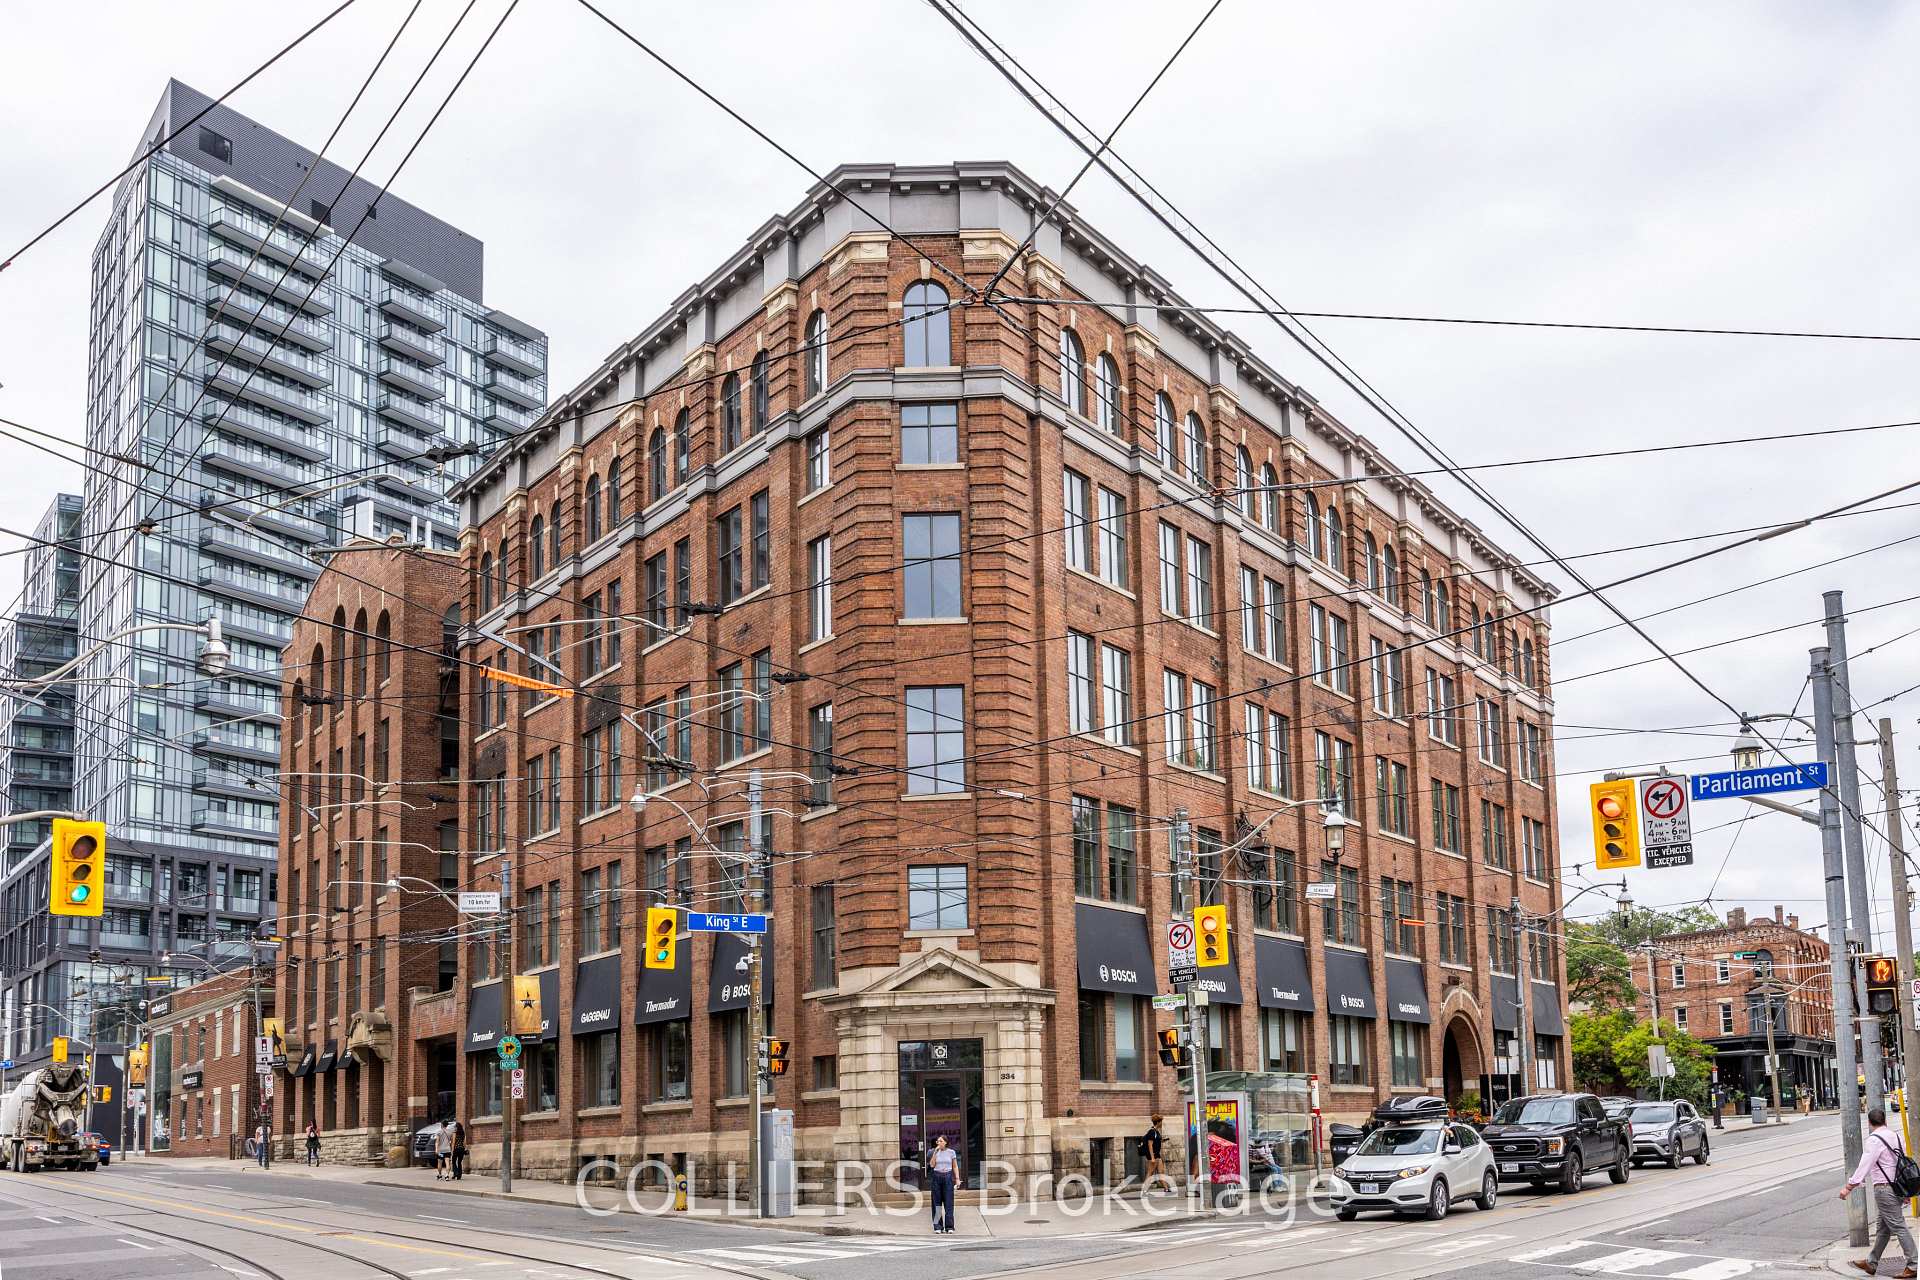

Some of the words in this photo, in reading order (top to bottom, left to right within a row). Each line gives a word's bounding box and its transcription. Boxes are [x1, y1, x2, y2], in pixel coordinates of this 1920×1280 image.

[1699, 768, 1804, 794] Parliament
[1808, 765, 1819, 775] St
[1662, 846, 1691, 855] VEHICLES
[1654, 856, 1687, 866] EXCEPTED
[706, 916, 730, 931] King
[741, 917, 748, 928] E
[1111, 969, 1136, 982] BOSCH
[732, 985, 751, 998] BOSC
[1199, 980, 1226, 992] AGGENAU
[1271, 987, 1300, 1000] Thermador
[645, 997, 679, 1013] Thermador
[1348, 997, 1365, 1008] BOSCH
[580, 1008, 610, 1023] GAGGENAU
[472, 1032, 496, 1042] Thermador
[501, 1060, 517, 1068] NORTH
